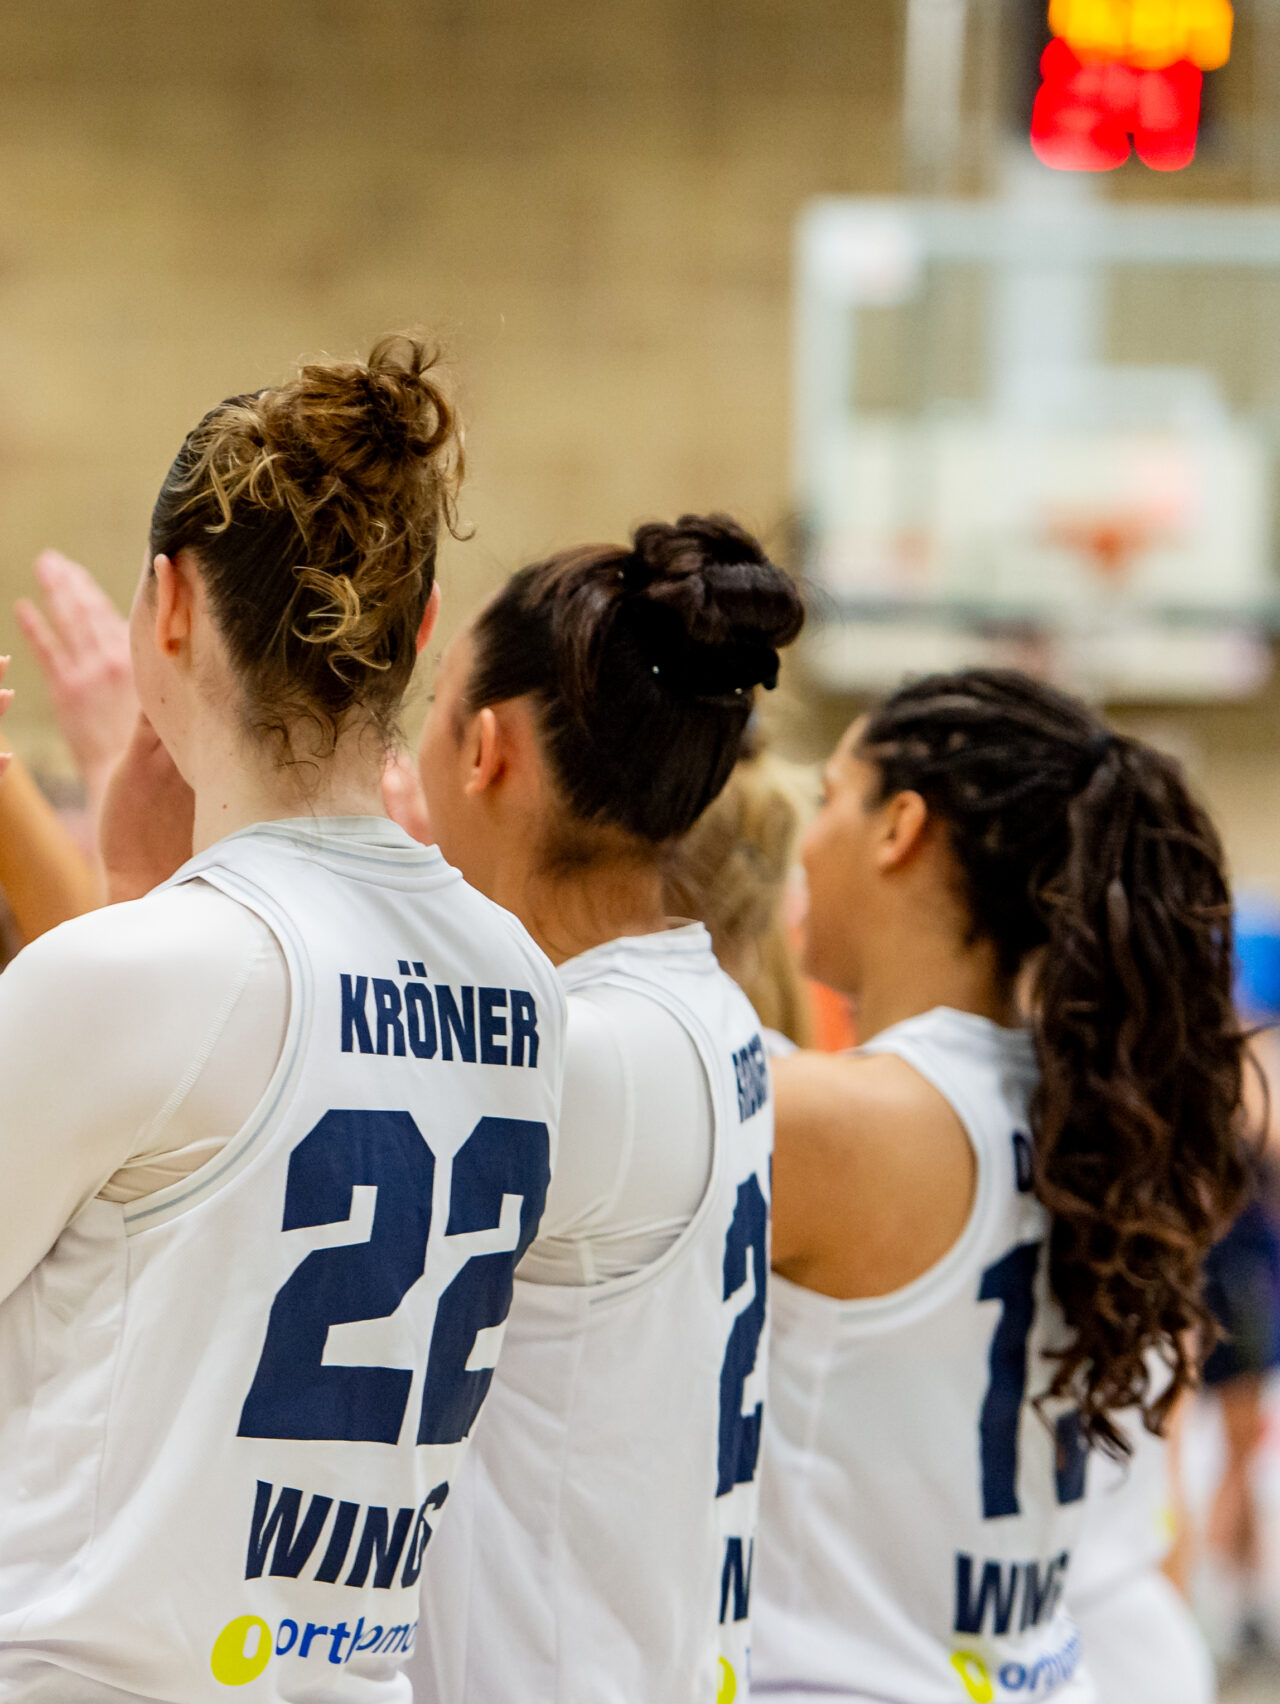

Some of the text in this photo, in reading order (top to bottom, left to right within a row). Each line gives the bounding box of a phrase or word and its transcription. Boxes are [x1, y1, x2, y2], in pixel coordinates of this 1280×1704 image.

[339, 959, 539, 1068] KRÖNER
[236, 1109, 552, 1446] 22
[716, 1152, 773, 1498] 2
[977, 1240, 1088, 1521] 1
[244, 1479, 450, 1590] WING
